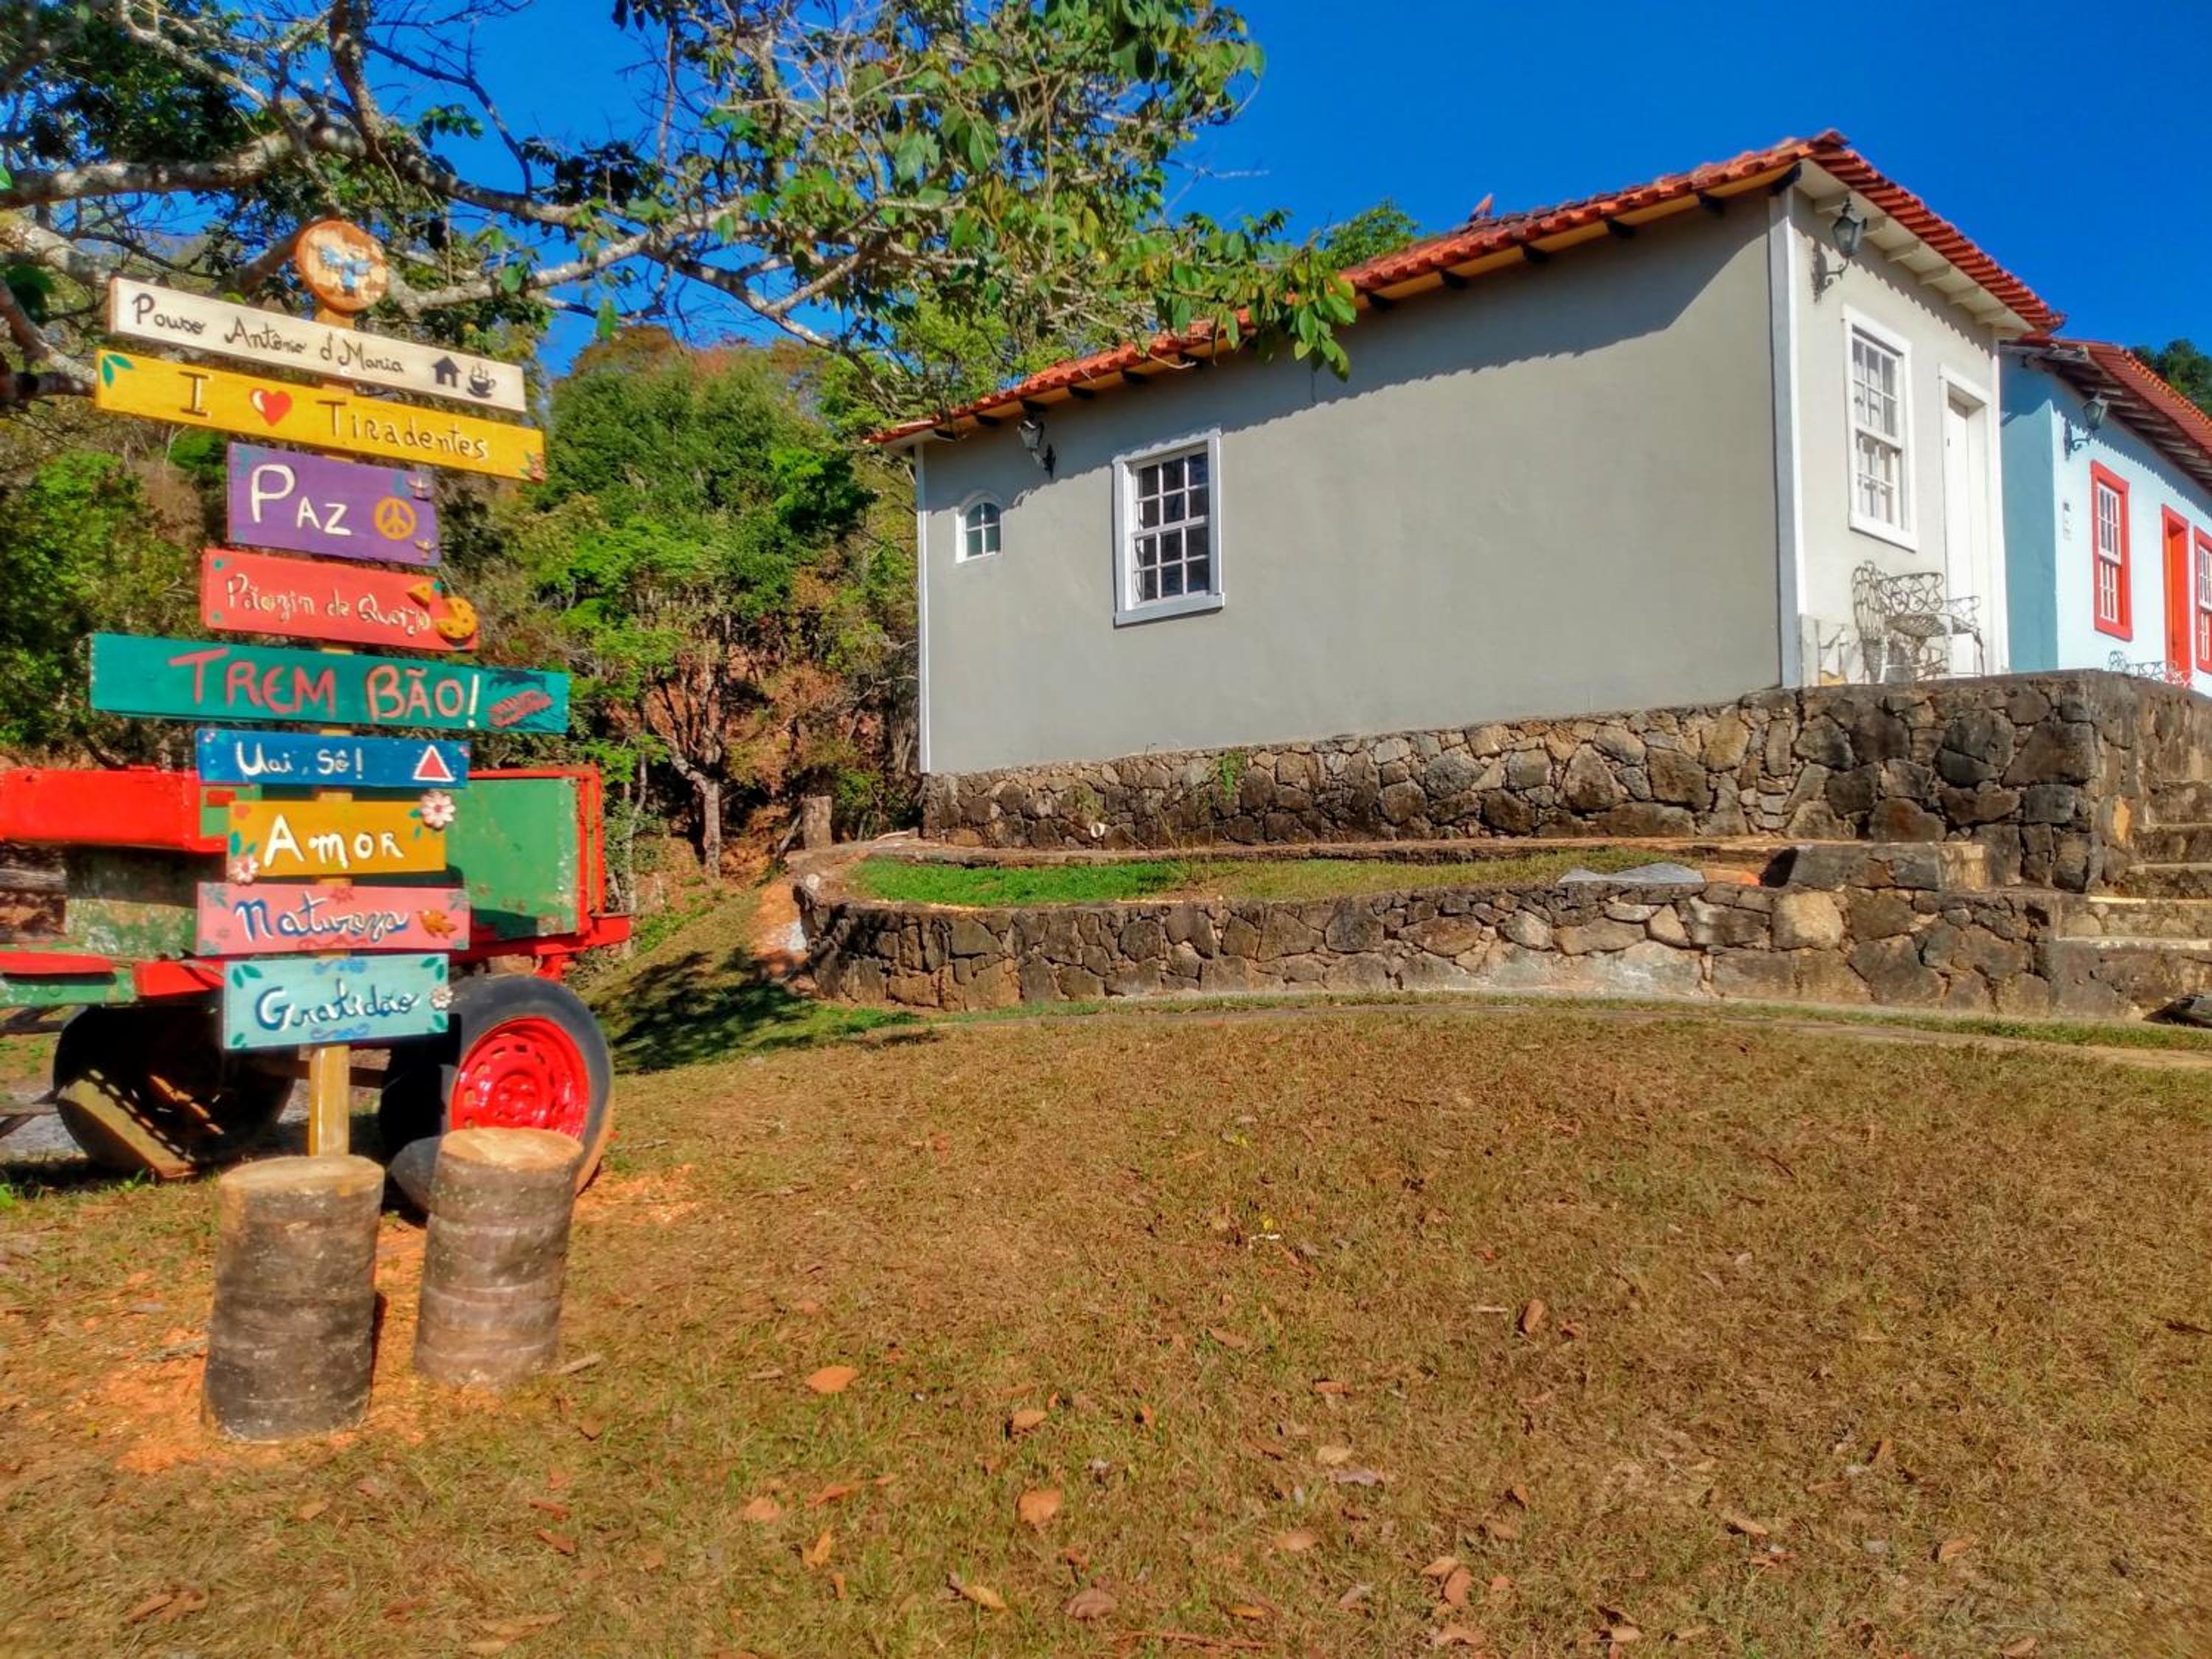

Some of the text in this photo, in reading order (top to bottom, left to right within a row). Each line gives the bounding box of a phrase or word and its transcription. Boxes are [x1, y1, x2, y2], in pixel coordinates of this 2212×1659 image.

[179, 371, 212, 417] I
[325, 590, 350, 616] de
[168, 648, 480, 728] TREM BÃO!
[234, 891, 410, 943] Natureza
[255, 978, 420, 1032] Gratidão
